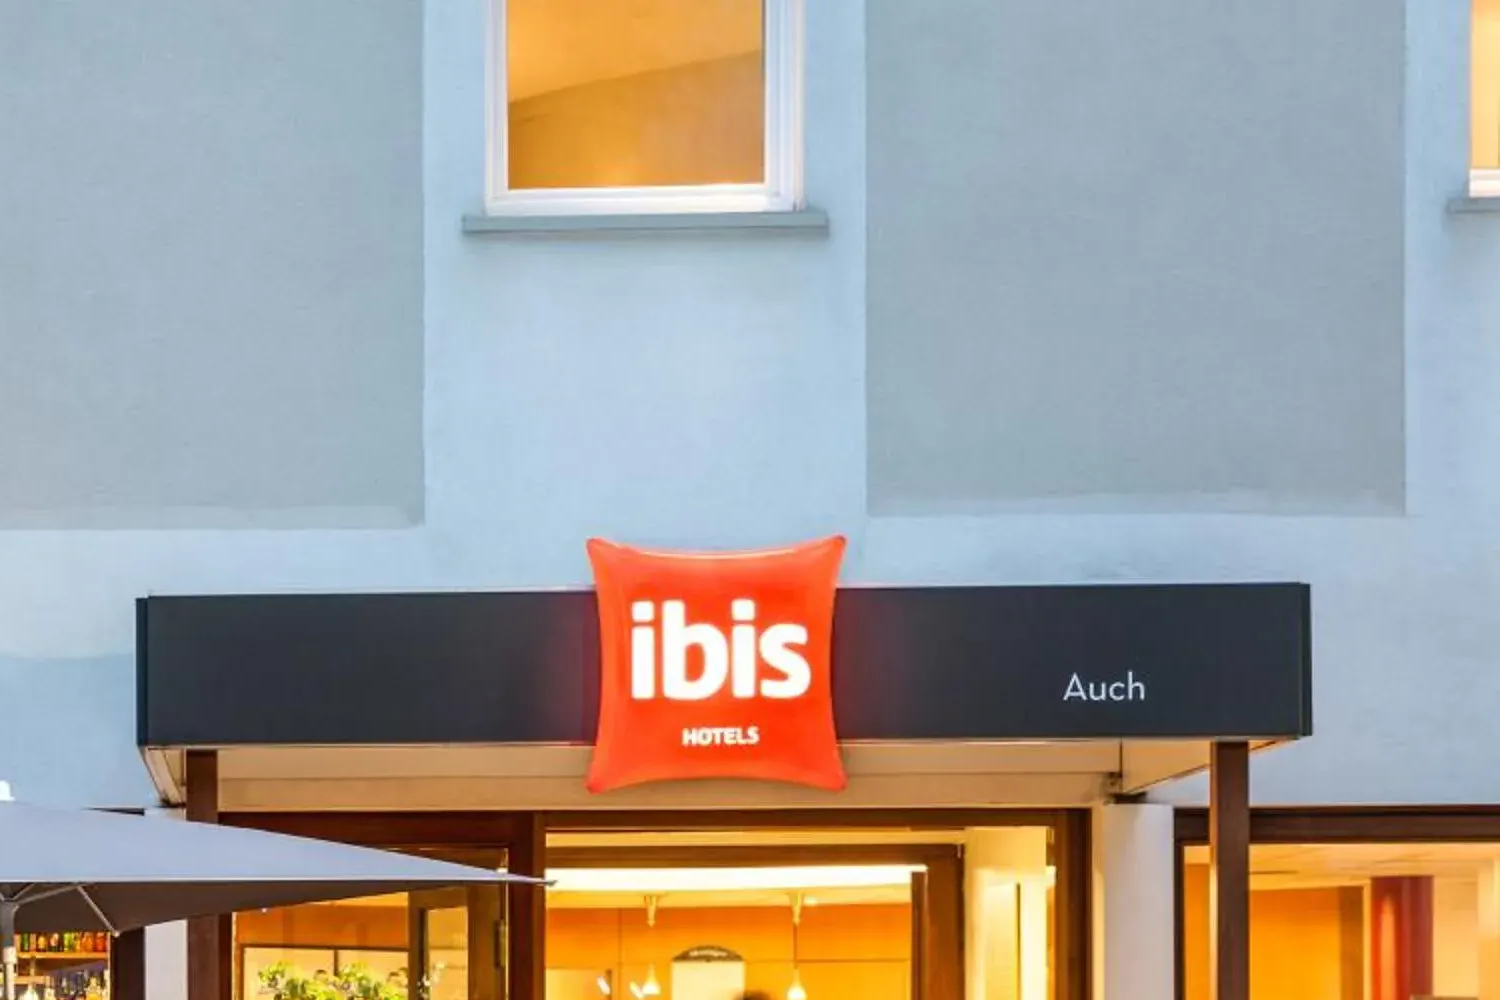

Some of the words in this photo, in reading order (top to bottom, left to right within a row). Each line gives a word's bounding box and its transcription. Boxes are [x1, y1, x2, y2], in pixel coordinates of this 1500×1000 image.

[631, 598, 812, 701] ibis
[1062, 670, 1146, 702] Auch
[682, 726, 760, 746] HOTELS
